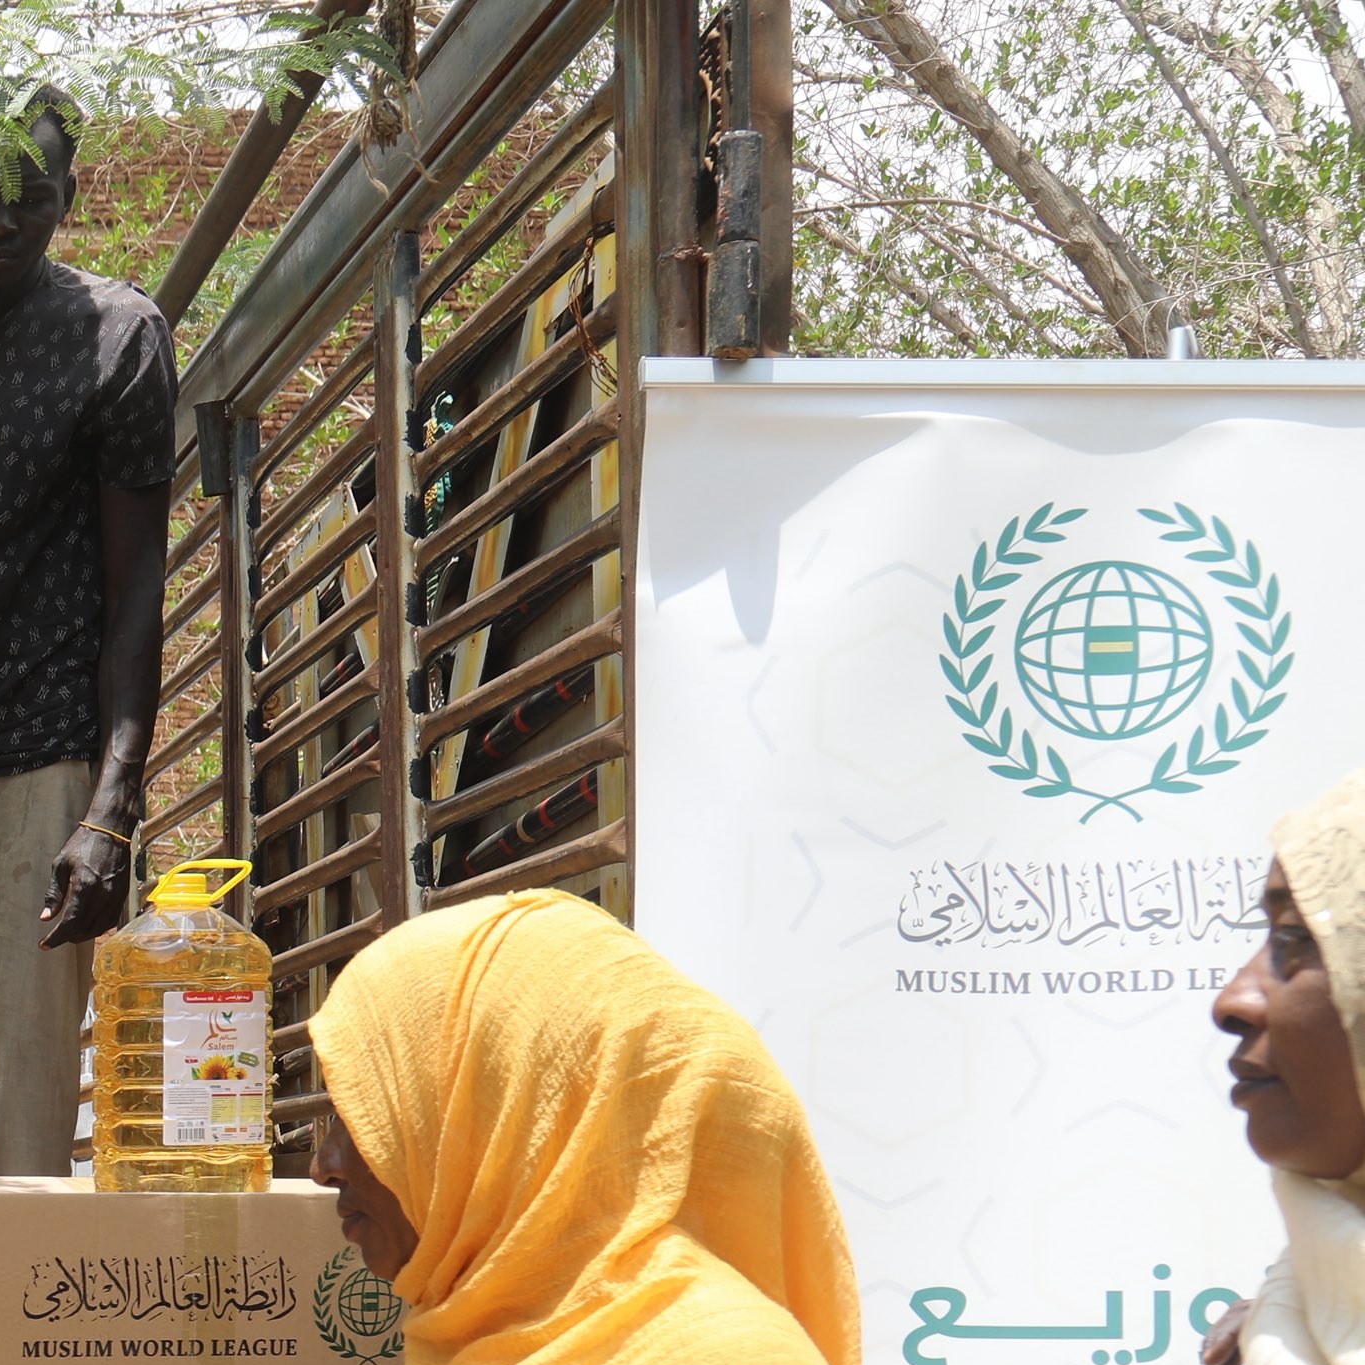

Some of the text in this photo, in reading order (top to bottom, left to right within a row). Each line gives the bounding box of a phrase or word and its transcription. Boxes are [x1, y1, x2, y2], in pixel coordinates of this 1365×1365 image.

[895, 969, 1031, 994] MUSLIM
[1043, 968, 1175, 994] WORLD
[207, 1043, 235, 1051] Salem
[22, 1339, 298, 1358] MUSLIM WORLD LEAGUE
